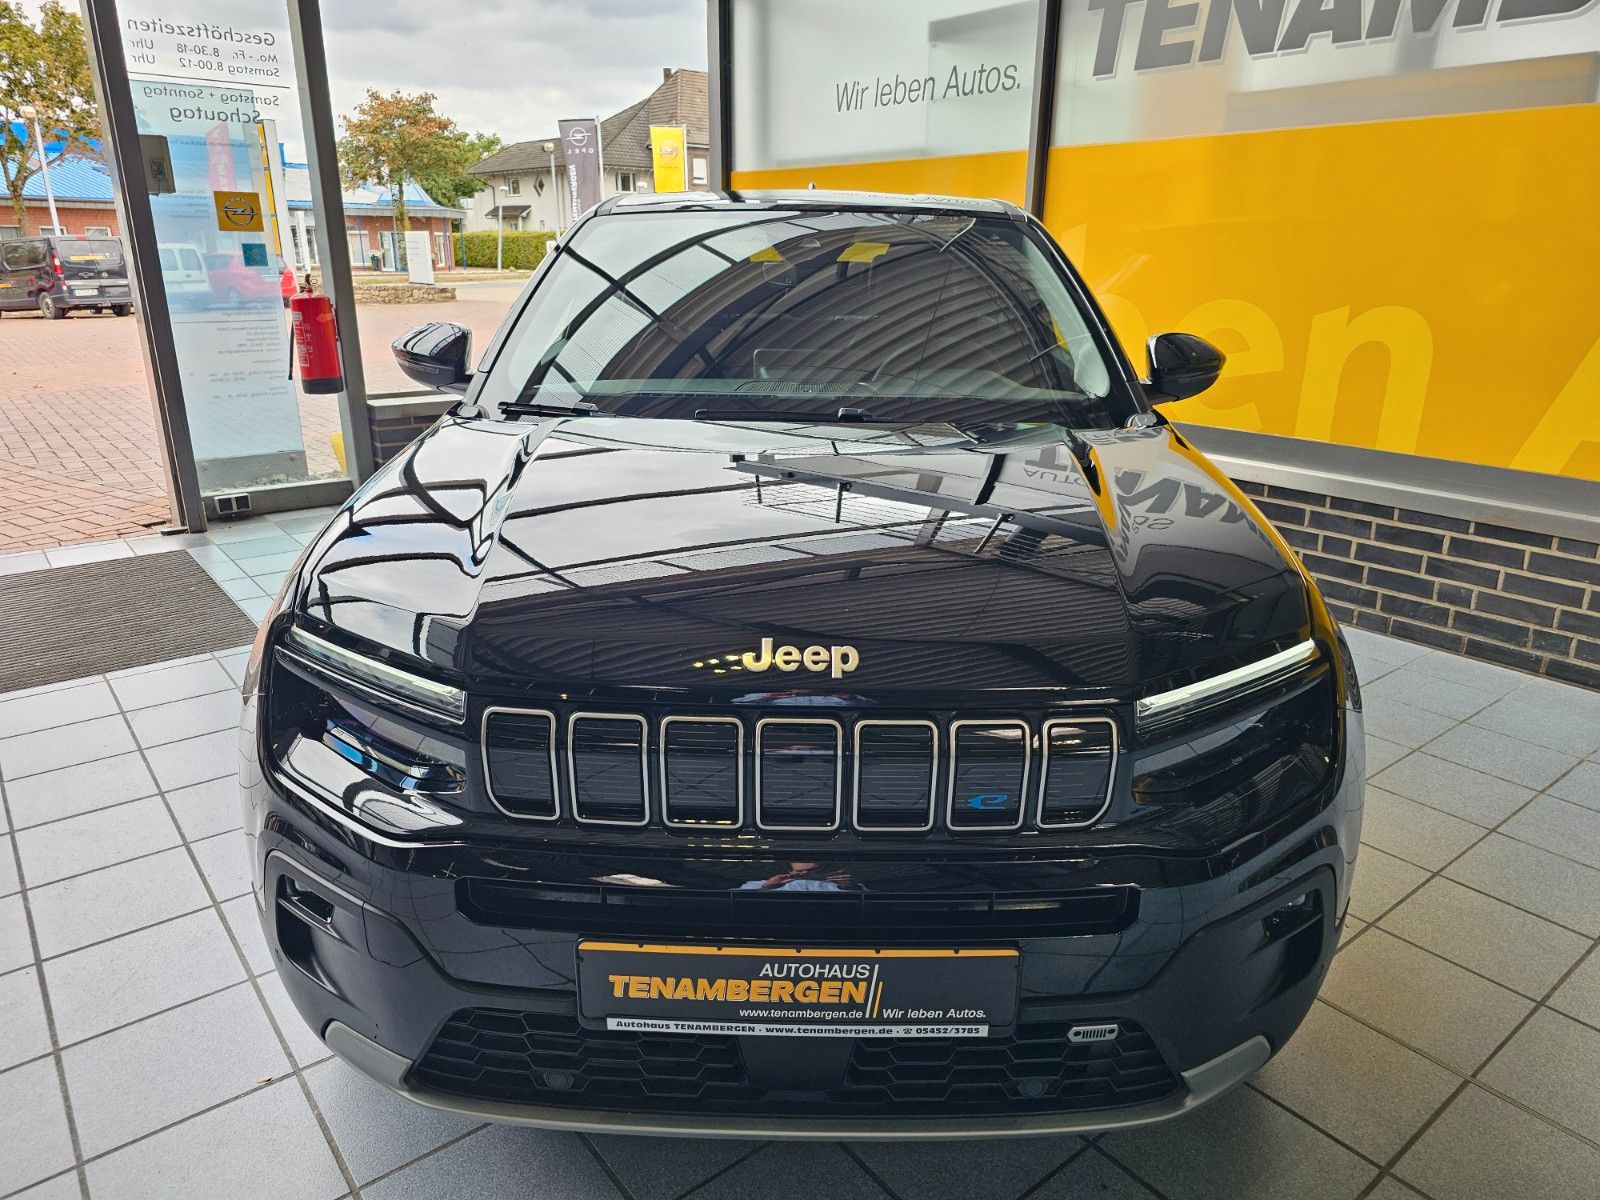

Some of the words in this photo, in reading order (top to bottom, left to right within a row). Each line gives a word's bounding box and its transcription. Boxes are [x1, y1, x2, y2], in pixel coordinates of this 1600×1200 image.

[836, 80, 869, 112] Wir
[874, 74, 936, 107] leben
[943, 63, 1021, 99] Autos.
[742, 637, 860, 679] Jeep
[759, 963, 871, 979] AUTOHAUS
[608, 974, 868, 1004] TENAMBERGEN
[739, 1008, 863, 1020] www.tenambergen.de
[882, 1008, 905, 1019] Wir
[907, 1008, 943, 1019] leben
[946, 1008, 987, 1019] Autos.
[616, 1020, 671, 1030] Autohaus
[674, 1023, 756, 1033] TENAMBERGEN
[765, 1026, 893, 1036] www.tenambergen.de
[915, 1026, 980, 1035] 05452/3785
